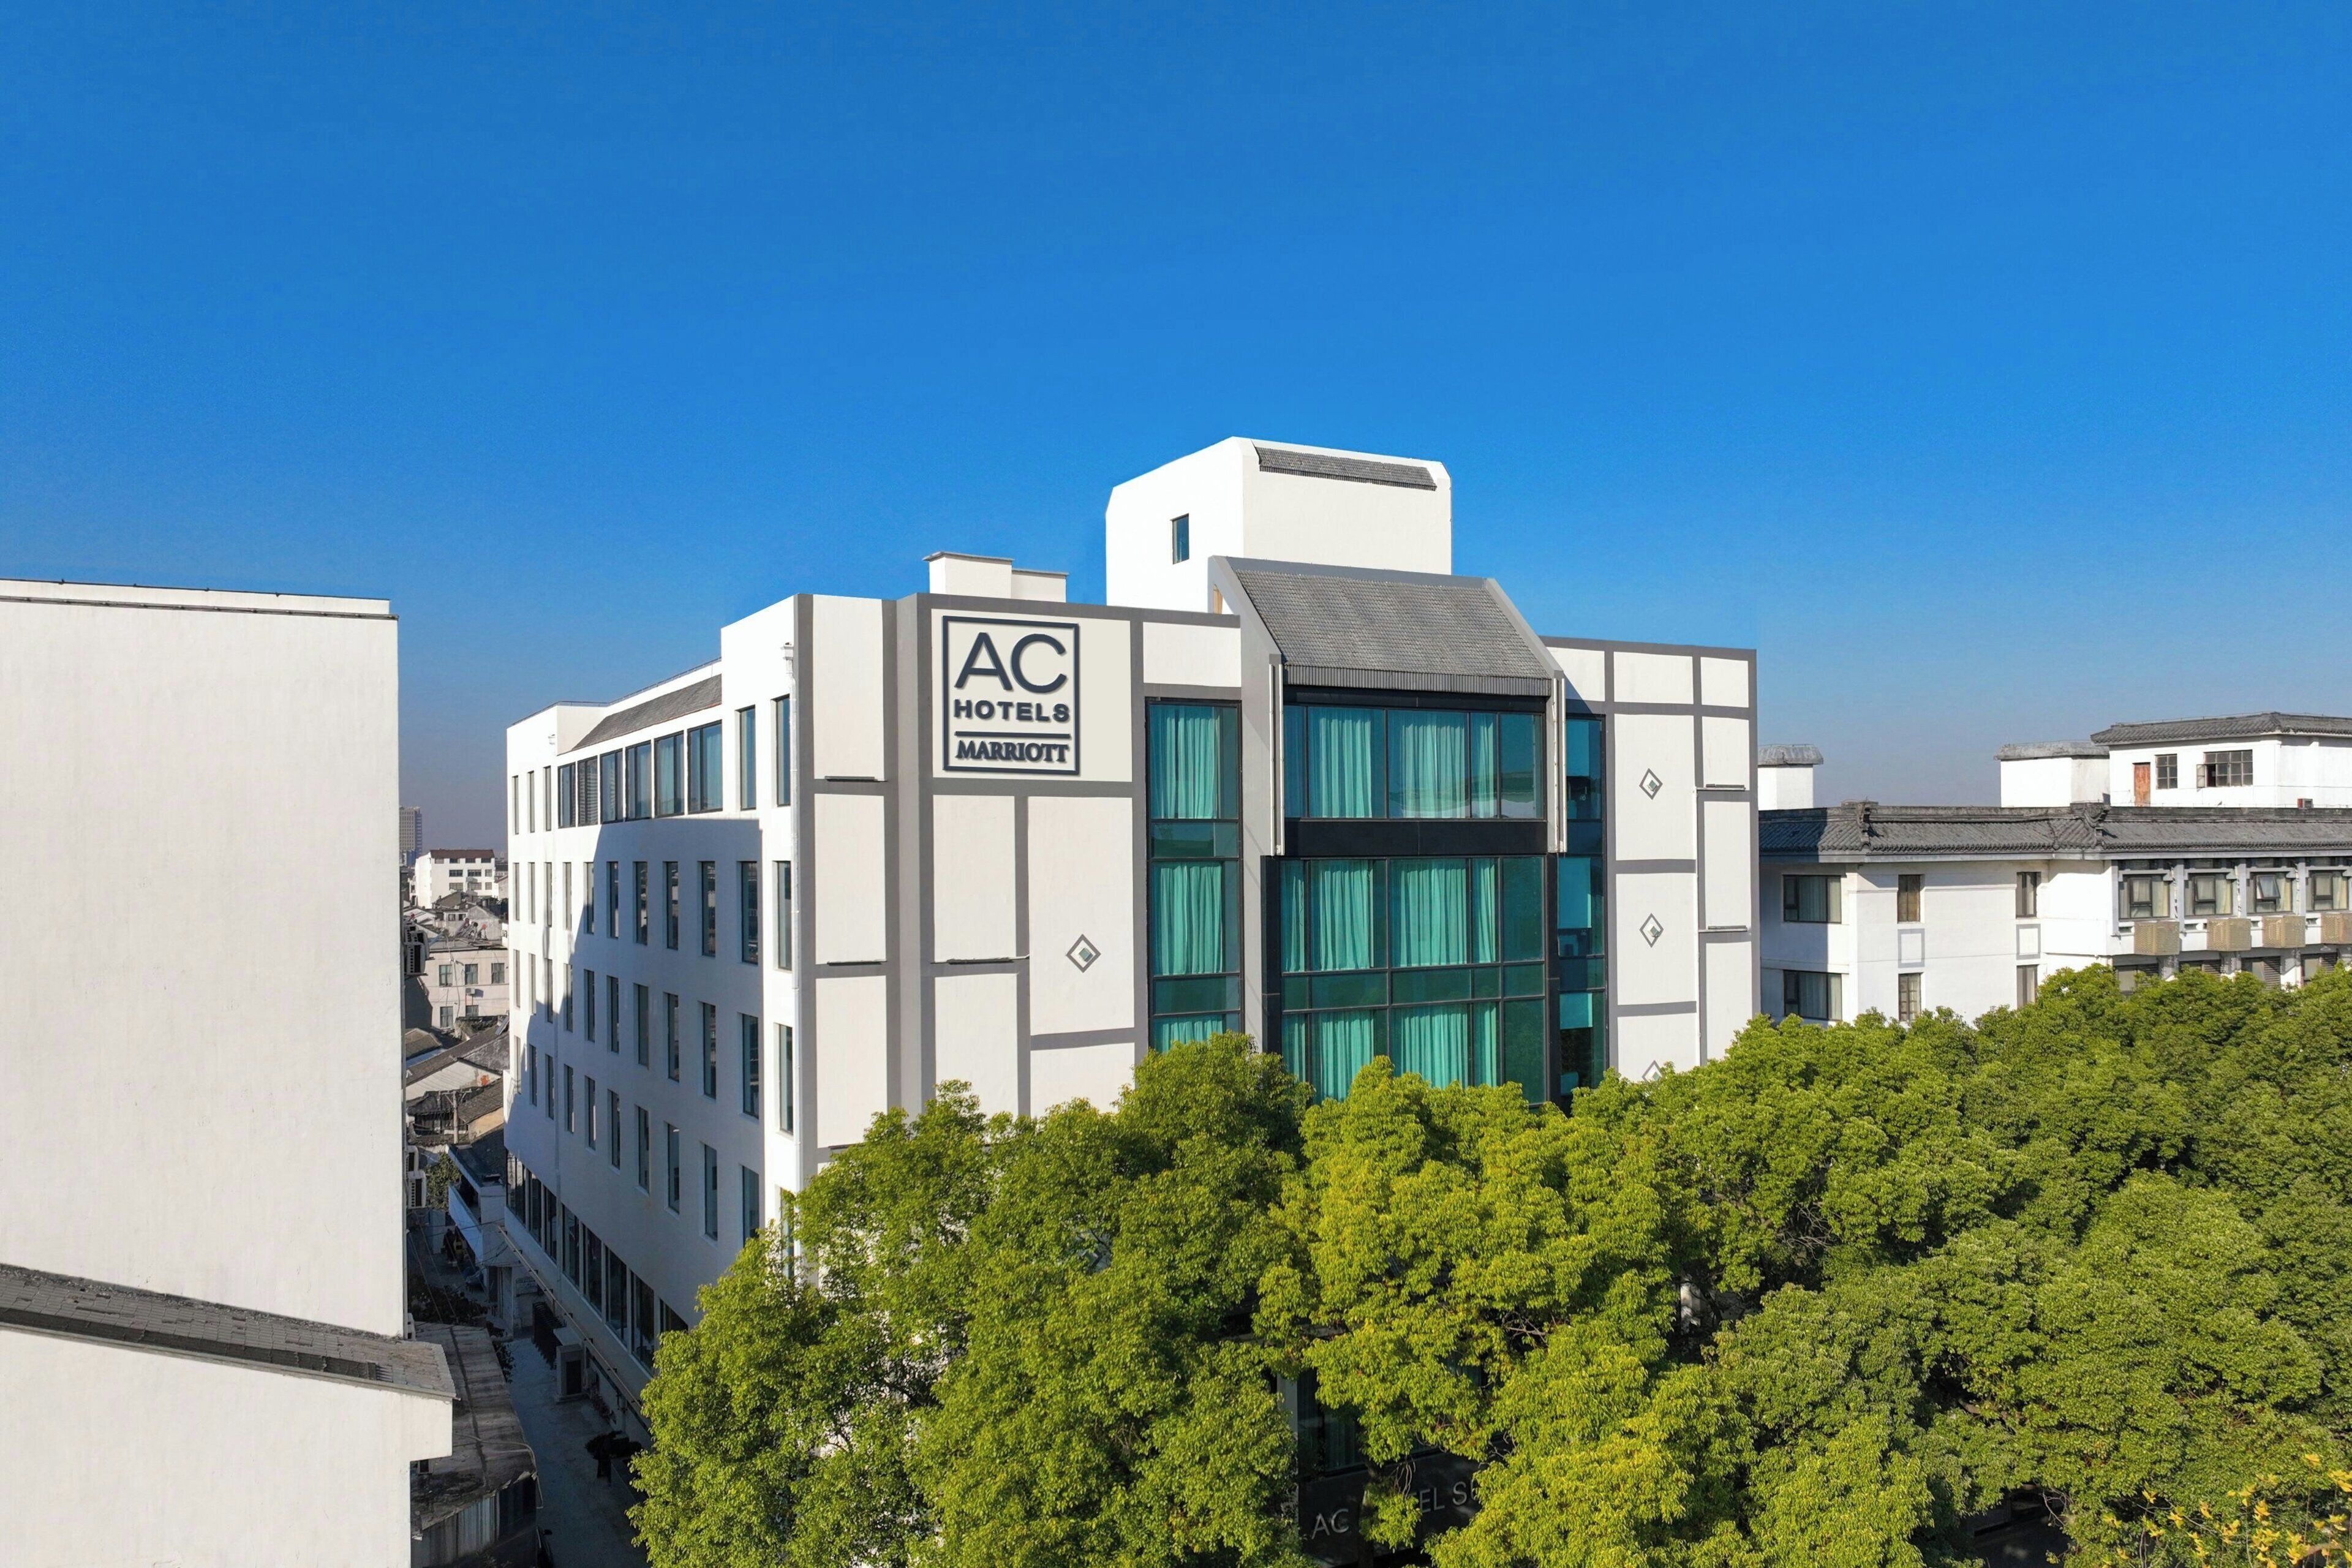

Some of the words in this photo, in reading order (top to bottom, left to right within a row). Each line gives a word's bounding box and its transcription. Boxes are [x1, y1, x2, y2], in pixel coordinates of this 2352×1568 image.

[954, 632, 1066, 693] AC
[954, 699, 1070, 722] HOTELS
[956, 740, 1069, 762] MARRIOTT
[1311, 1509, 1349, 1539] AC
